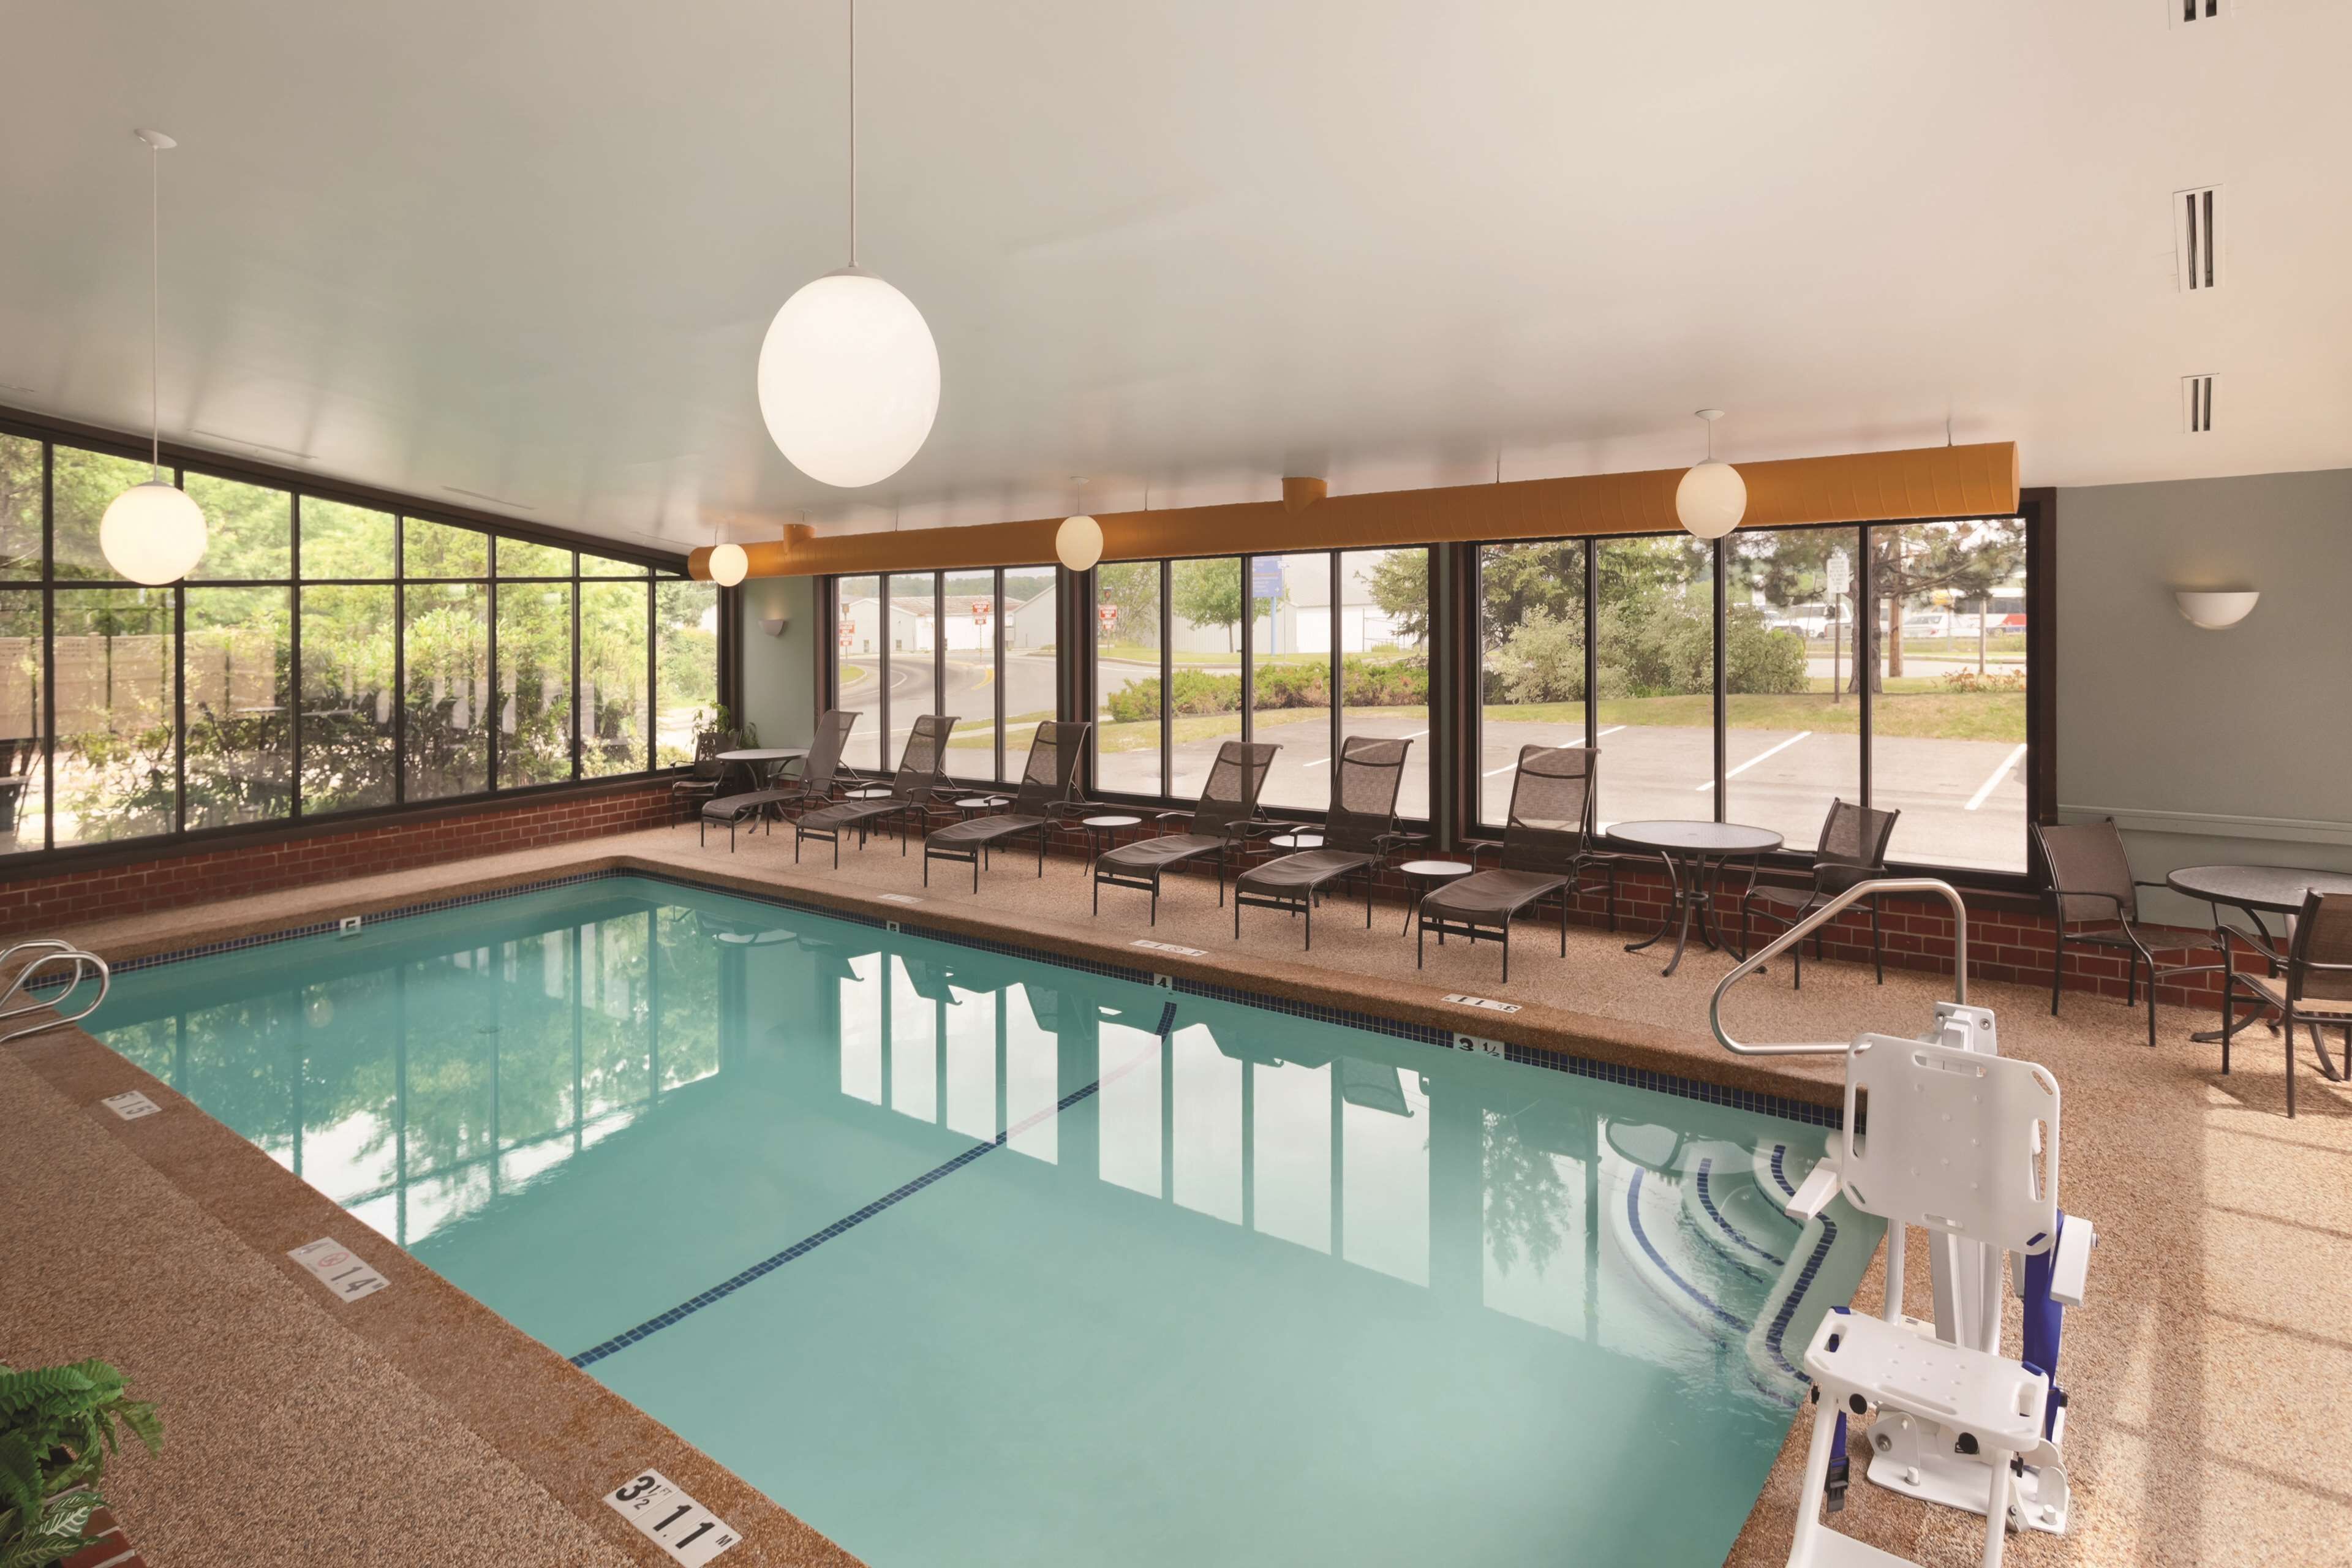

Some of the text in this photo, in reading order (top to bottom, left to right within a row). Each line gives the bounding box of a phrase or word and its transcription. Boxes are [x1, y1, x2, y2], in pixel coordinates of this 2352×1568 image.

[1156, 977, 1169, 988] 4
[1459, 1037, 1474, 1052] 3
[715, 1534, 733, 1548] M
